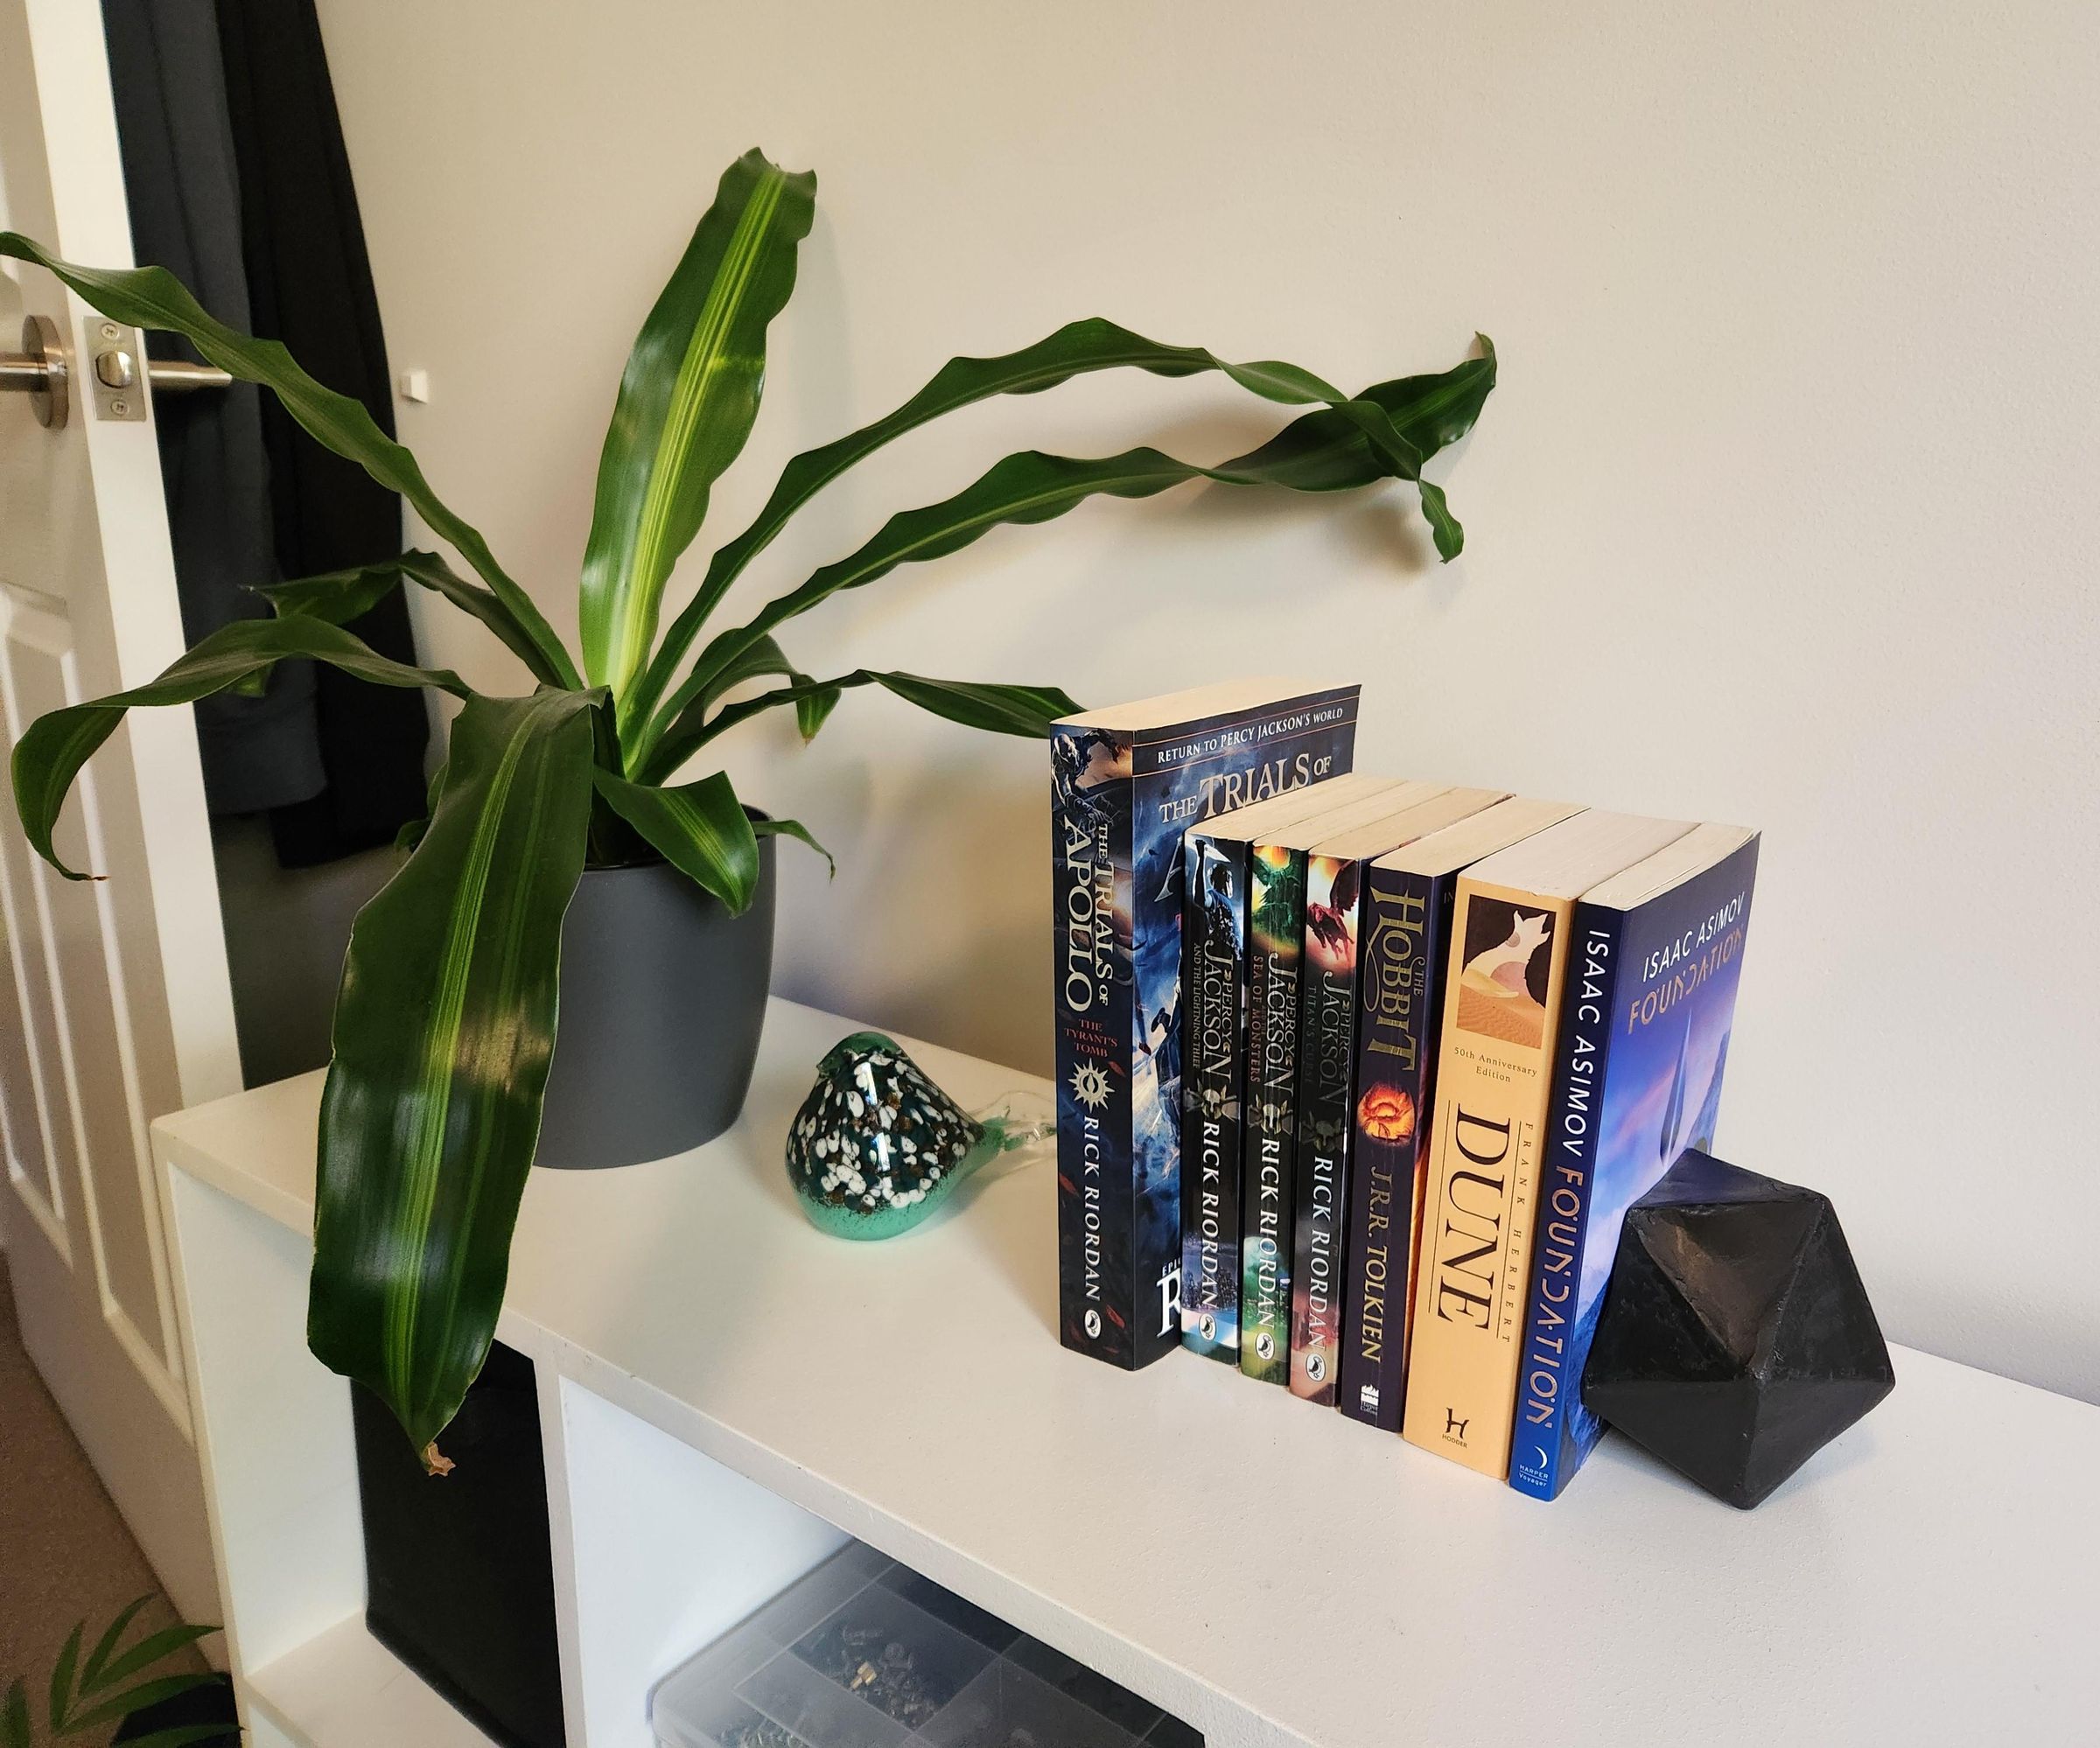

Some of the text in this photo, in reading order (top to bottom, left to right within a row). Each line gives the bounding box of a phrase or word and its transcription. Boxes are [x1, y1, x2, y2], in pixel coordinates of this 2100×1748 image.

[1158, 708, 1343, 764] RETURN TO PERCY JACKSON'S WORLD
[1158, 753, 1332, 823] THE TRIALS OF
[1064, 815, 1092, 1012] APOLLO
[1095, 823, 1114, 1006] THE TRIALS OF
[1642, 891, 1745, 983] ISAAC ASIMOV
[1079, 1018, 1102, 1032] THE
[1193, 988, 1201, 1038] LIGHTNING
[1201, 940, 1234, 1084] JACKSON
[1222, 982, 1233, 1045] PERCY
[1250, 955, 1263, 1083] SEA OF MONSTERS
[1264, 952, 1298, 1097] JACKSON
[1284, 994, 1297, 1058] PERCY
[1364, 885, 1425, 1072] HOBBIT
[1413, 957, 1426, 996] THE
[1628, 927, 1743, 1035] FOUNDATION
[1065, 1027, 1118, 1048] TYRANT'S
[1074, 1041, 1109, 1058] TOMB
[1193, 1041, 1201, 1068] THIEF
[1319, 970, 1352, 1105] JACKSON
[1454, 1046, 1537, 1077] 50th Anniversary
[1475, 1066, 1511, 1083] Edition
[1084, 1116, 1101, 1301] RICK RIORDAN
[1201, 1122, 1221, 1310] RICK RIORDAN
[1438, 1103, 1510, 1330] DUNE
[1526, 930, 1611, 1429] ISAAC ASIMOV FOUNDATION
[1257, 1138, 1279, 1330] RICK RIORDAN
[1307, 1156, 1334, 1351] RICK RIORDAN
[1361, 1166, 1393, 1363] J.R.R. TOLKIEN
[1502, 1122, 1534, 1343] FRANK HERBERT
[1442, 1434, 1467, 1449] HODDER
[1518, 1472, 1548, 1487] Voyager
[1519, 1464, 1549, 1479] HARPER
